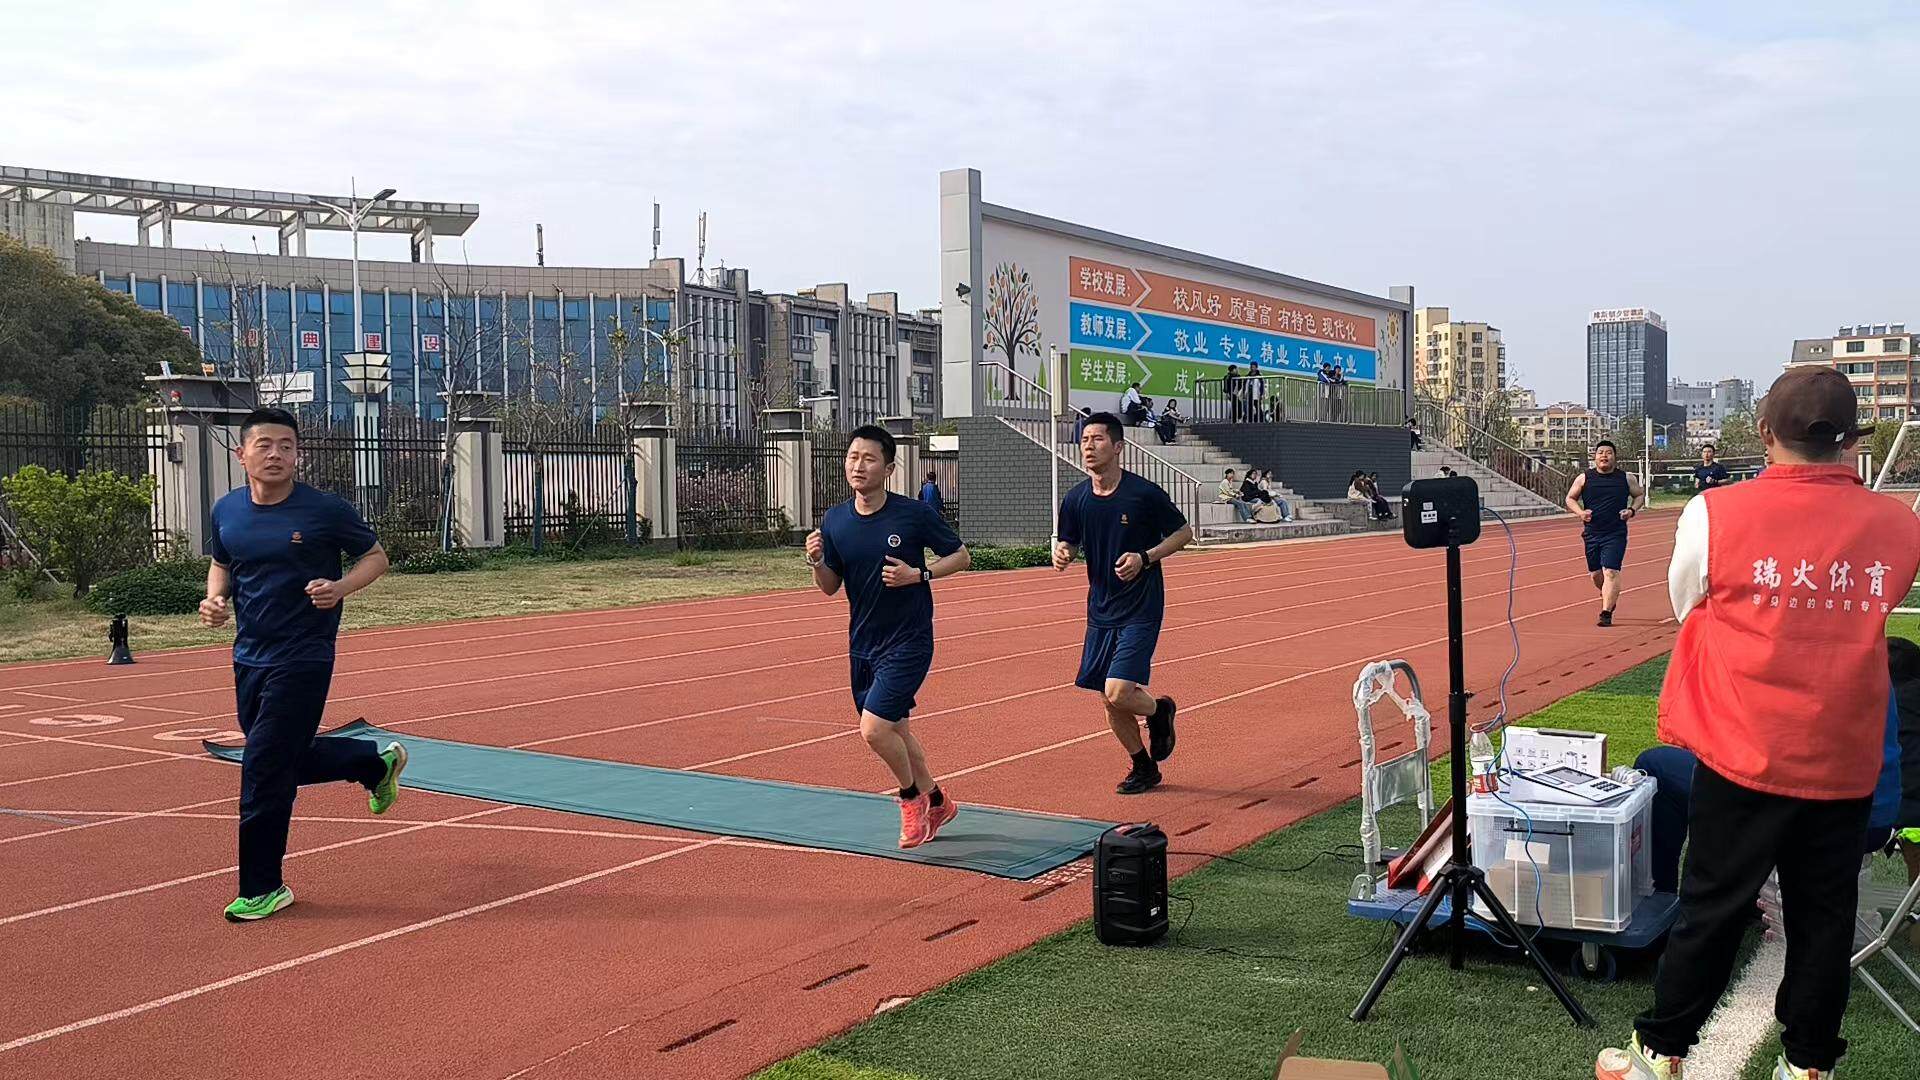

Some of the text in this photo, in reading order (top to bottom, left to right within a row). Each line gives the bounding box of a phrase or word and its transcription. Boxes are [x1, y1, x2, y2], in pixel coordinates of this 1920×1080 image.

[1173, 286, 1357, 341] 校风好 质量高 有特色 现代化
[1174, 328, 1209, 355] 敬业
[1219, 334, 1252, 360] 专业
[1260, 341, 1290, 366] 精业
[1298, 347, 1324, 370] 乐业
[1752, 556, 1892, 597] 瑞火体育
